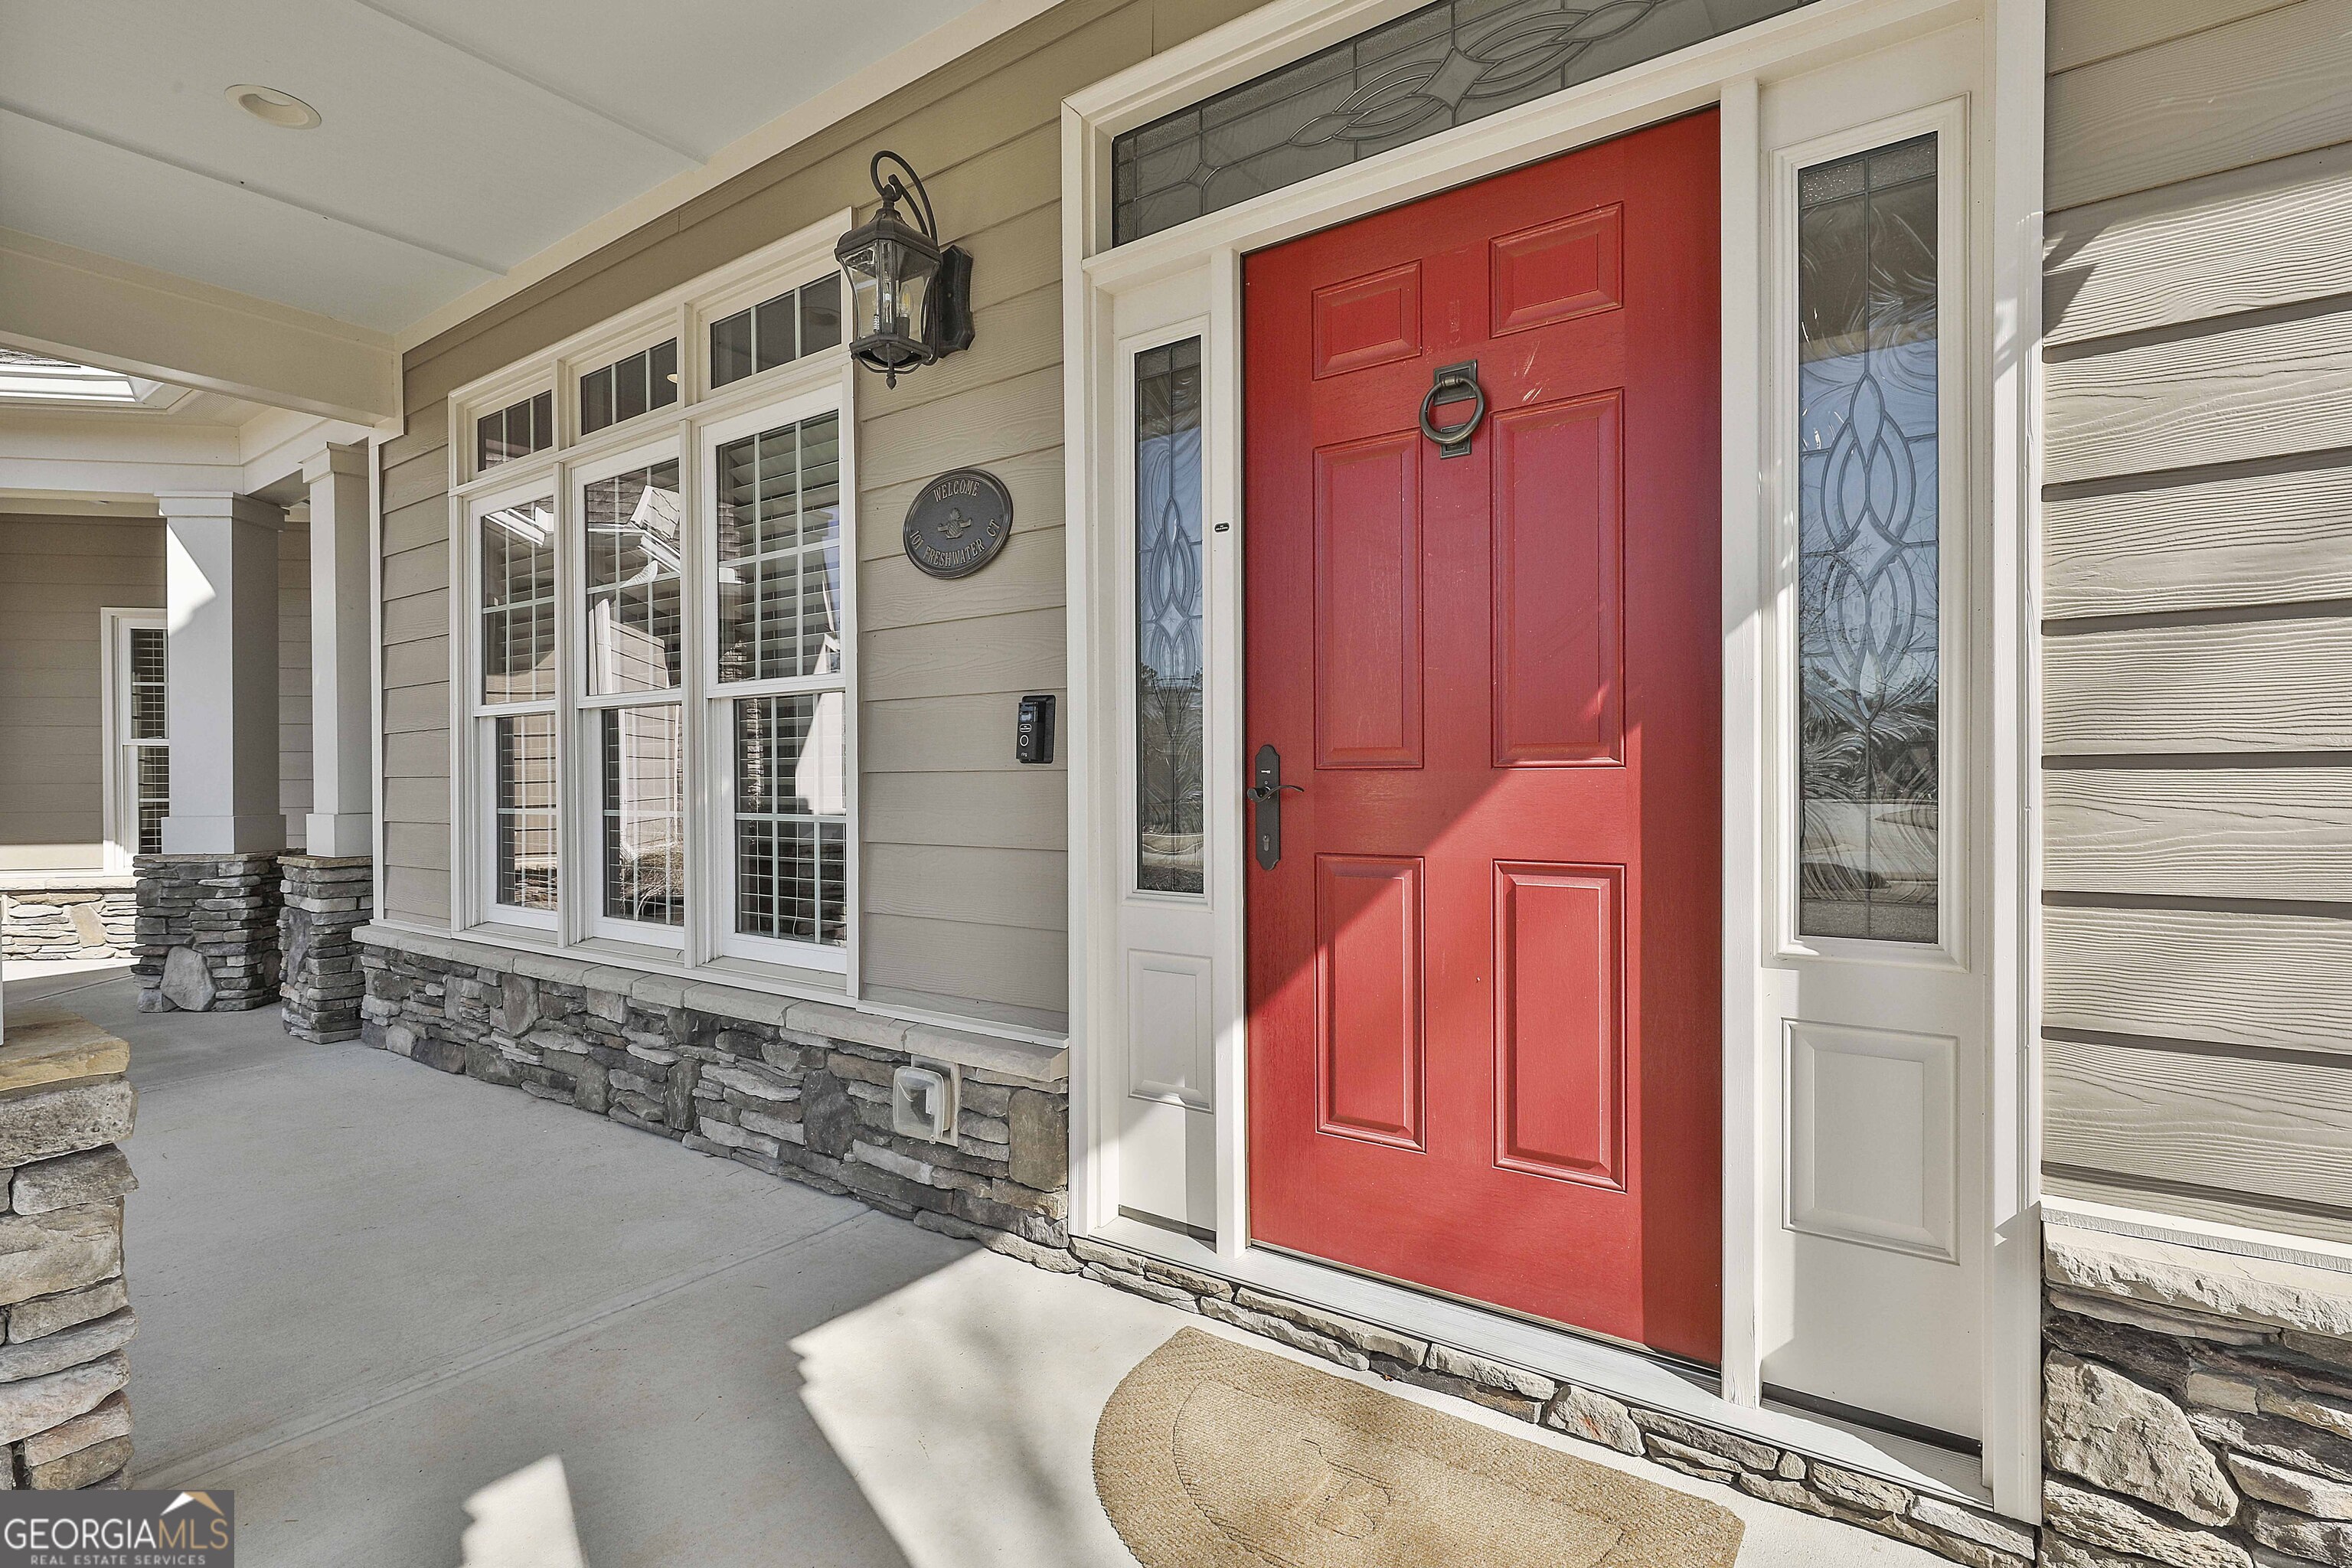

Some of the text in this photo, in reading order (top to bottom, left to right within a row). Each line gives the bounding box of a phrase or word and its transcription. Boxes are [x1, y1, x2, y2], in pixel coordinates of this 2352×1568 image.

[933, 479, 981, 502] WELCOME
[910, 519, 1000, 567] 101 FRESHWATER CT
